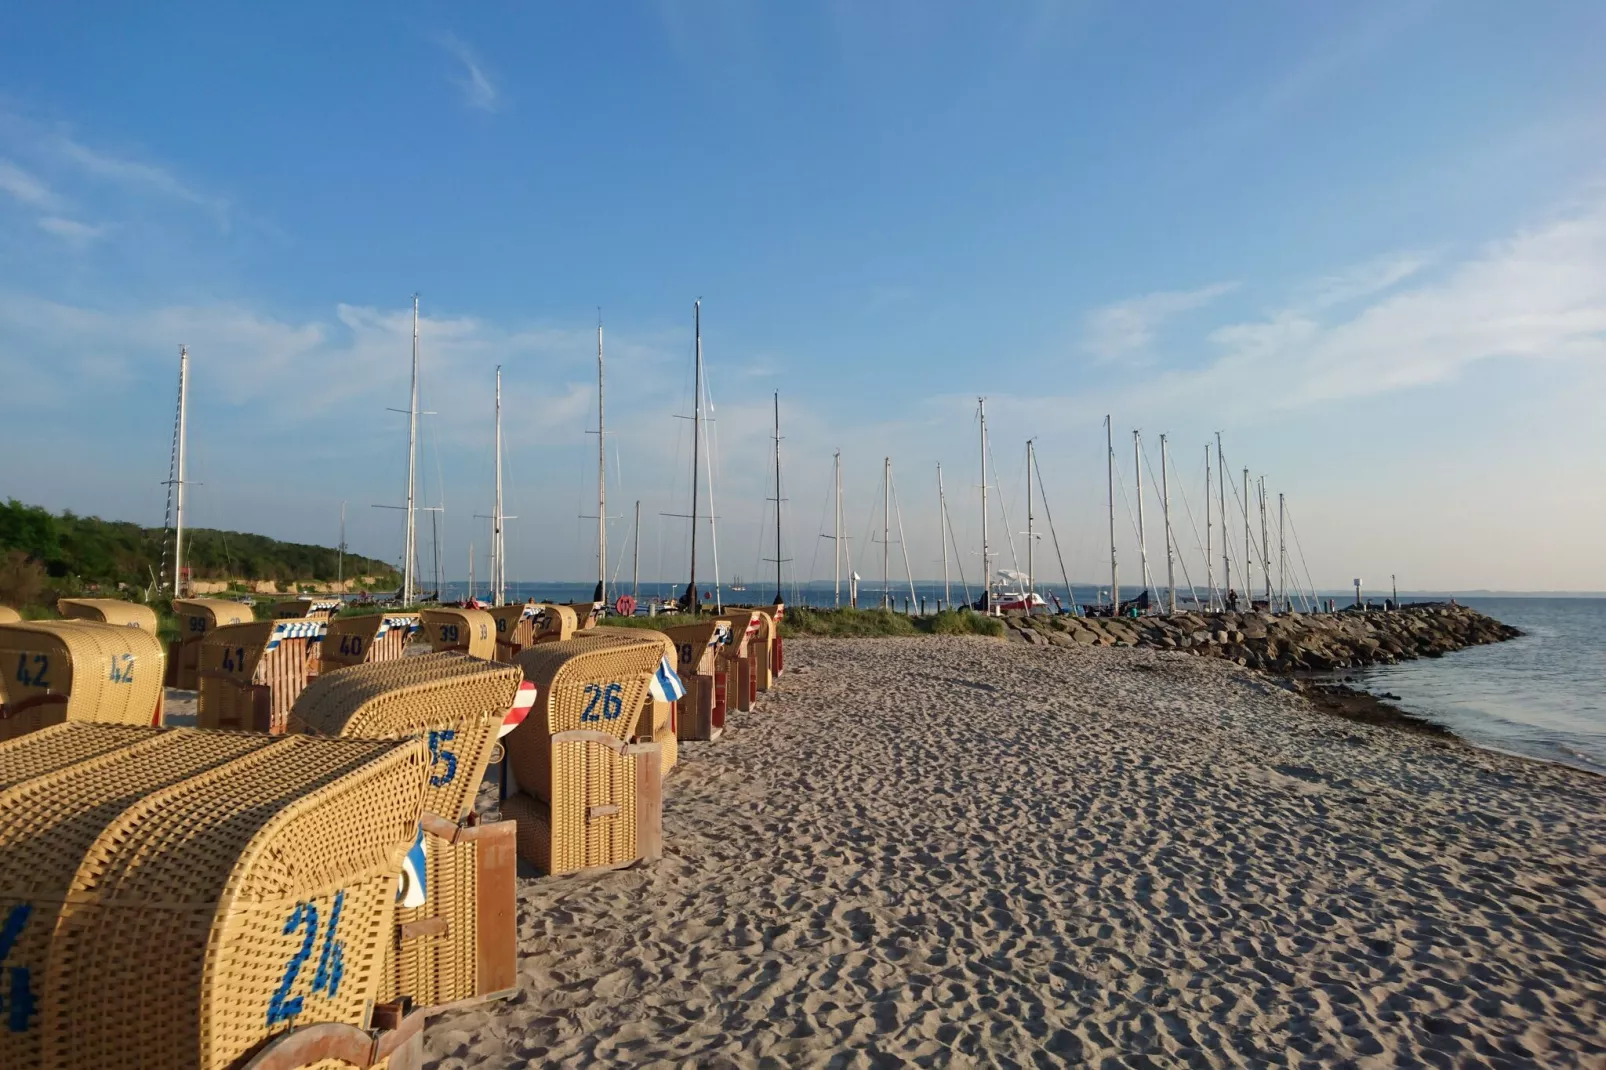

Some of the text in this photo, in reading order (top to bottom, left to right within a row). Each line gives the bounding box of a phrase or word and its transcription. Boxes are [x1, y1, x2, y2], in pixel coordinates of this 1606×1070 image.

[189, 617, 206, 631] 99
[440, 625, 458, 642] 39
[340, 635, 362, 656] 40
[16, 652, 50, 688] 42
[109, 653, 135, 683] 42
[222, 648, 244, 672] 41
[581, 682, 622, 722] 26
[266, 889, 346, 1028] 24
